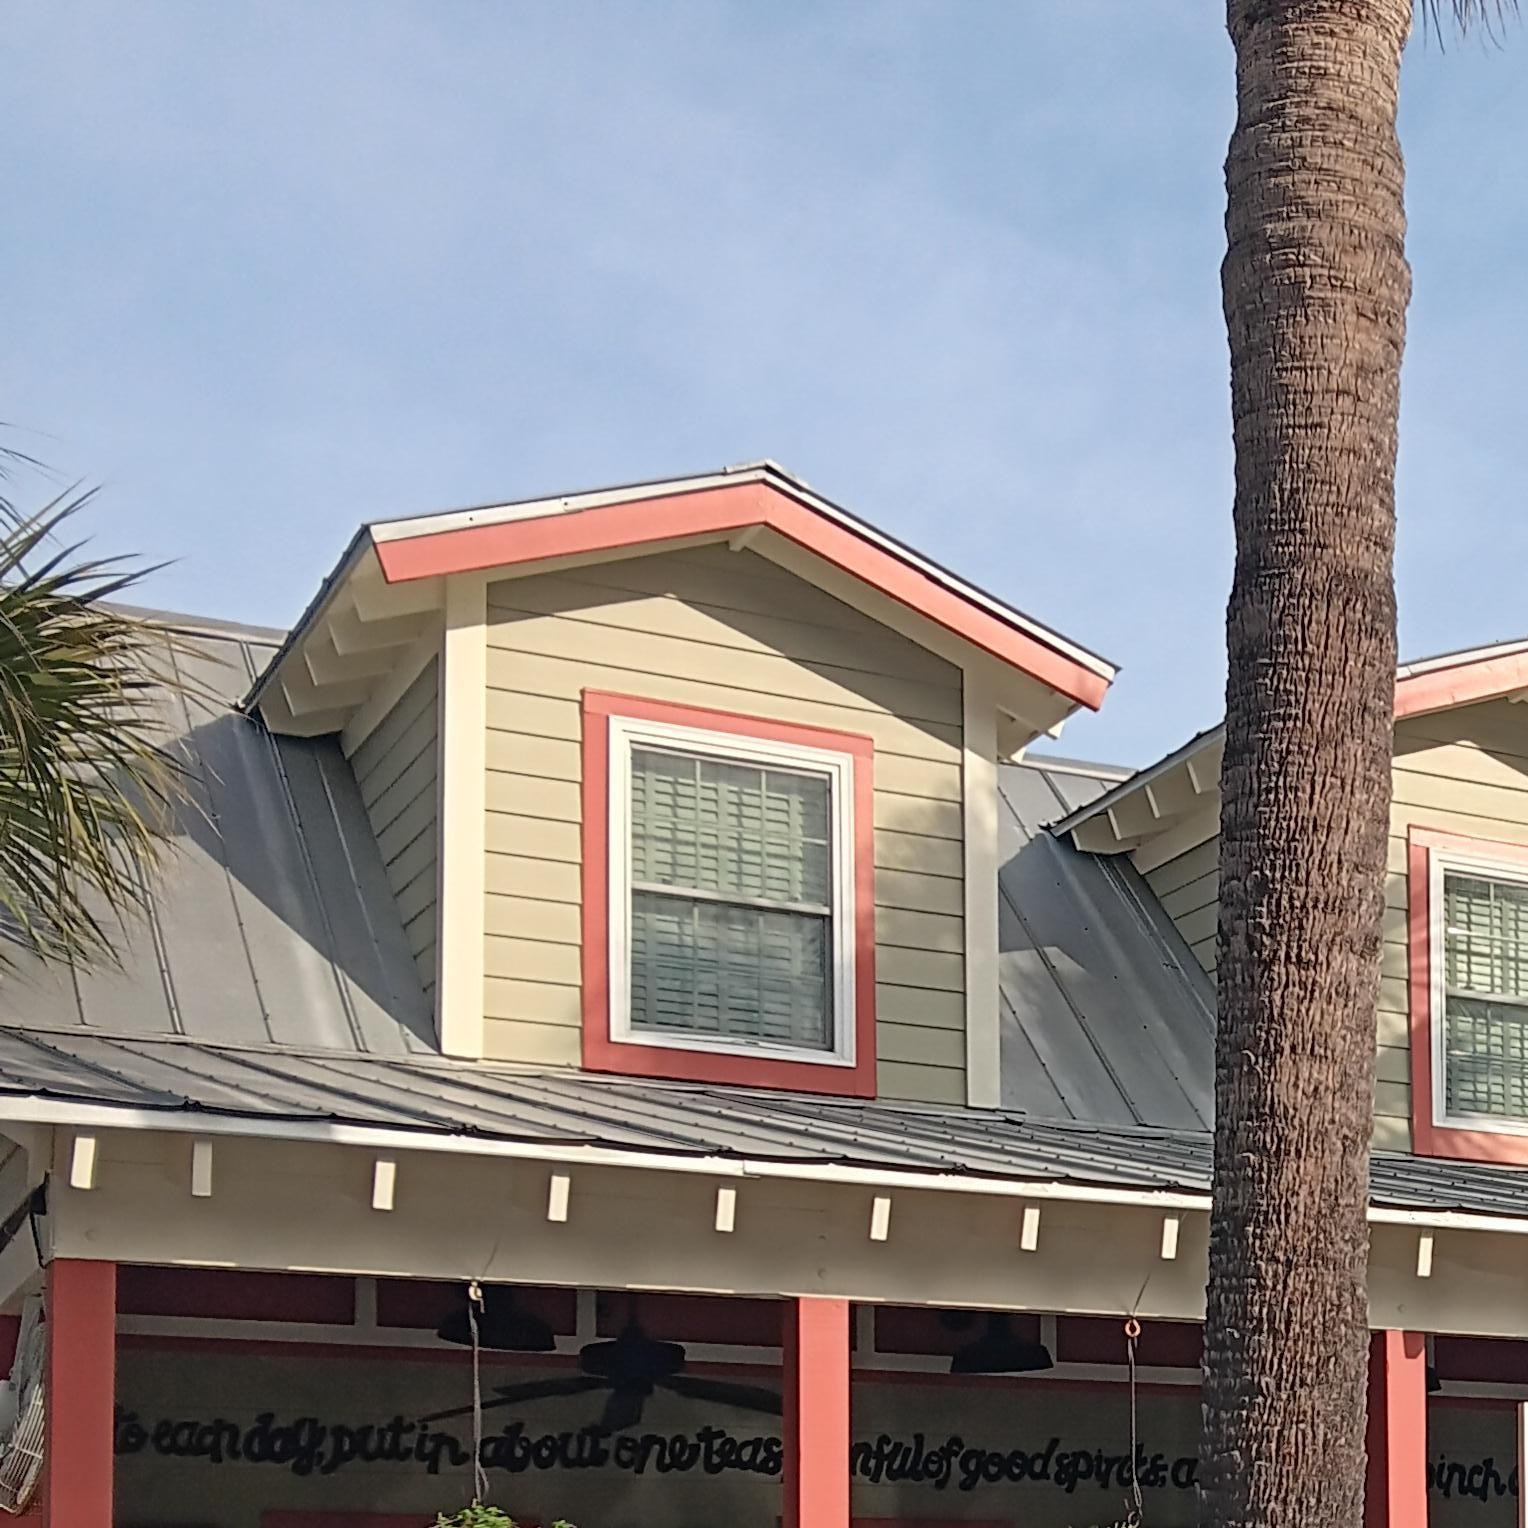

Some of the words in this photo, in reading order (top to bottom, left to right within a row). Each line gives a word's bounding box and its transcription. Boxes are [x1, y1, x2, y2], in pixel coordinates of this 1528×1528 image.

[321, 1415, 415, 1474] put
[414, 1423, 470, 1474] in
[479, 1421, 611, 1473] about
[614, 1433, 698, 1474] one
[922, 1436, 964, 1490] of
[959, 1438, 1061, 1491] good
